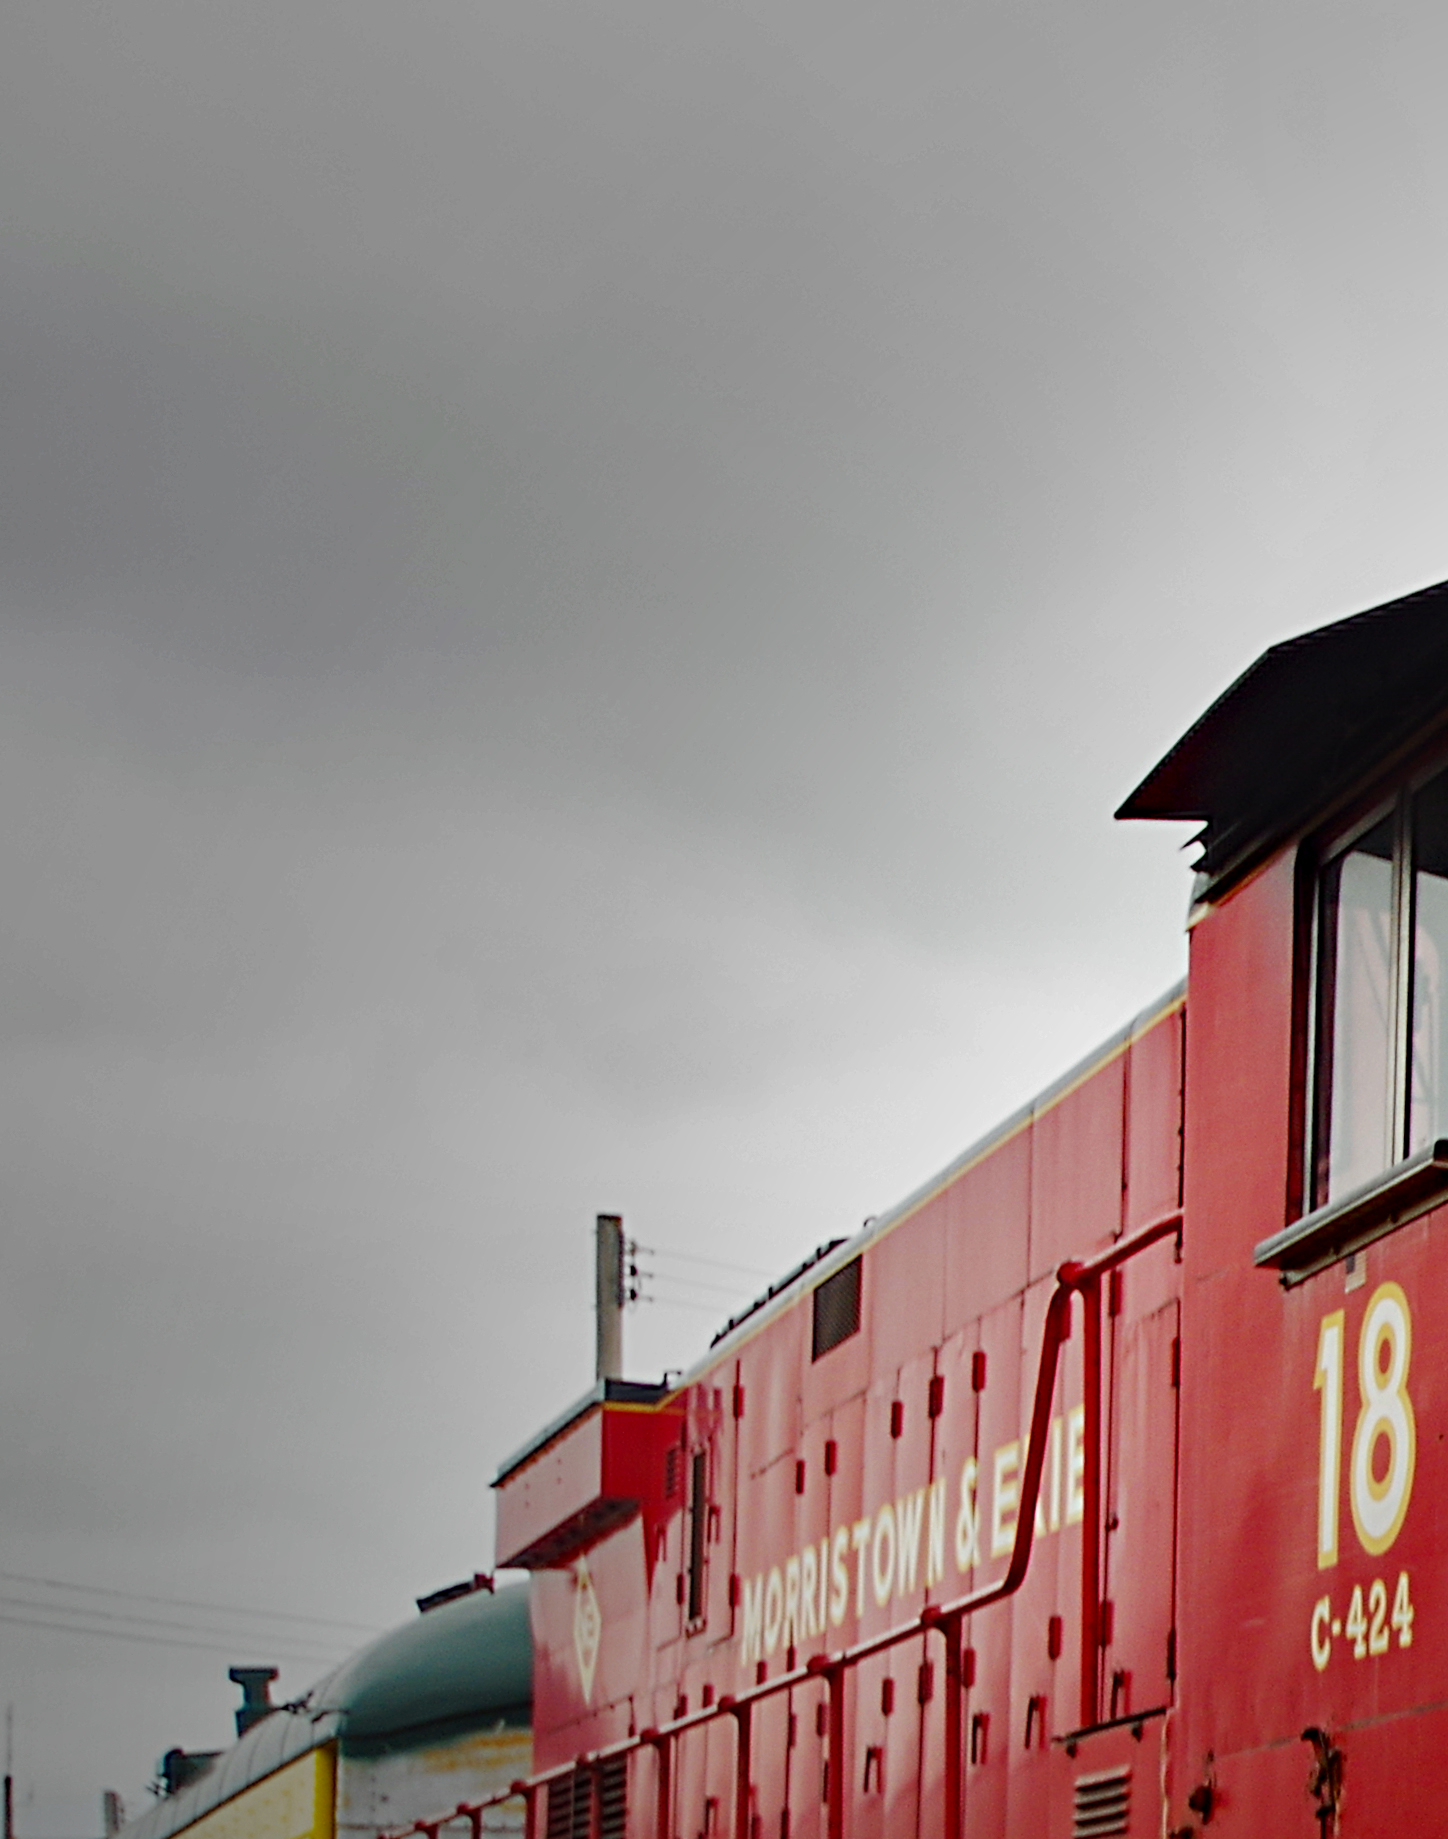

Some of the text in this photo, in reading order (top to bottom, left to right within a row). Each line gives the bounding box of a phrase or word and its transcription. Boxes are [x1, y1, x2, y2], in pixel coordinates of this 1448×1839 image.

[1312, 1280, 1418, 1571] 18
[741, 1476, 947, 1667] MORRISTOWN
[956, 1455, 982, 1574] &
[1310, 1569, 1415, 1673] C-424
